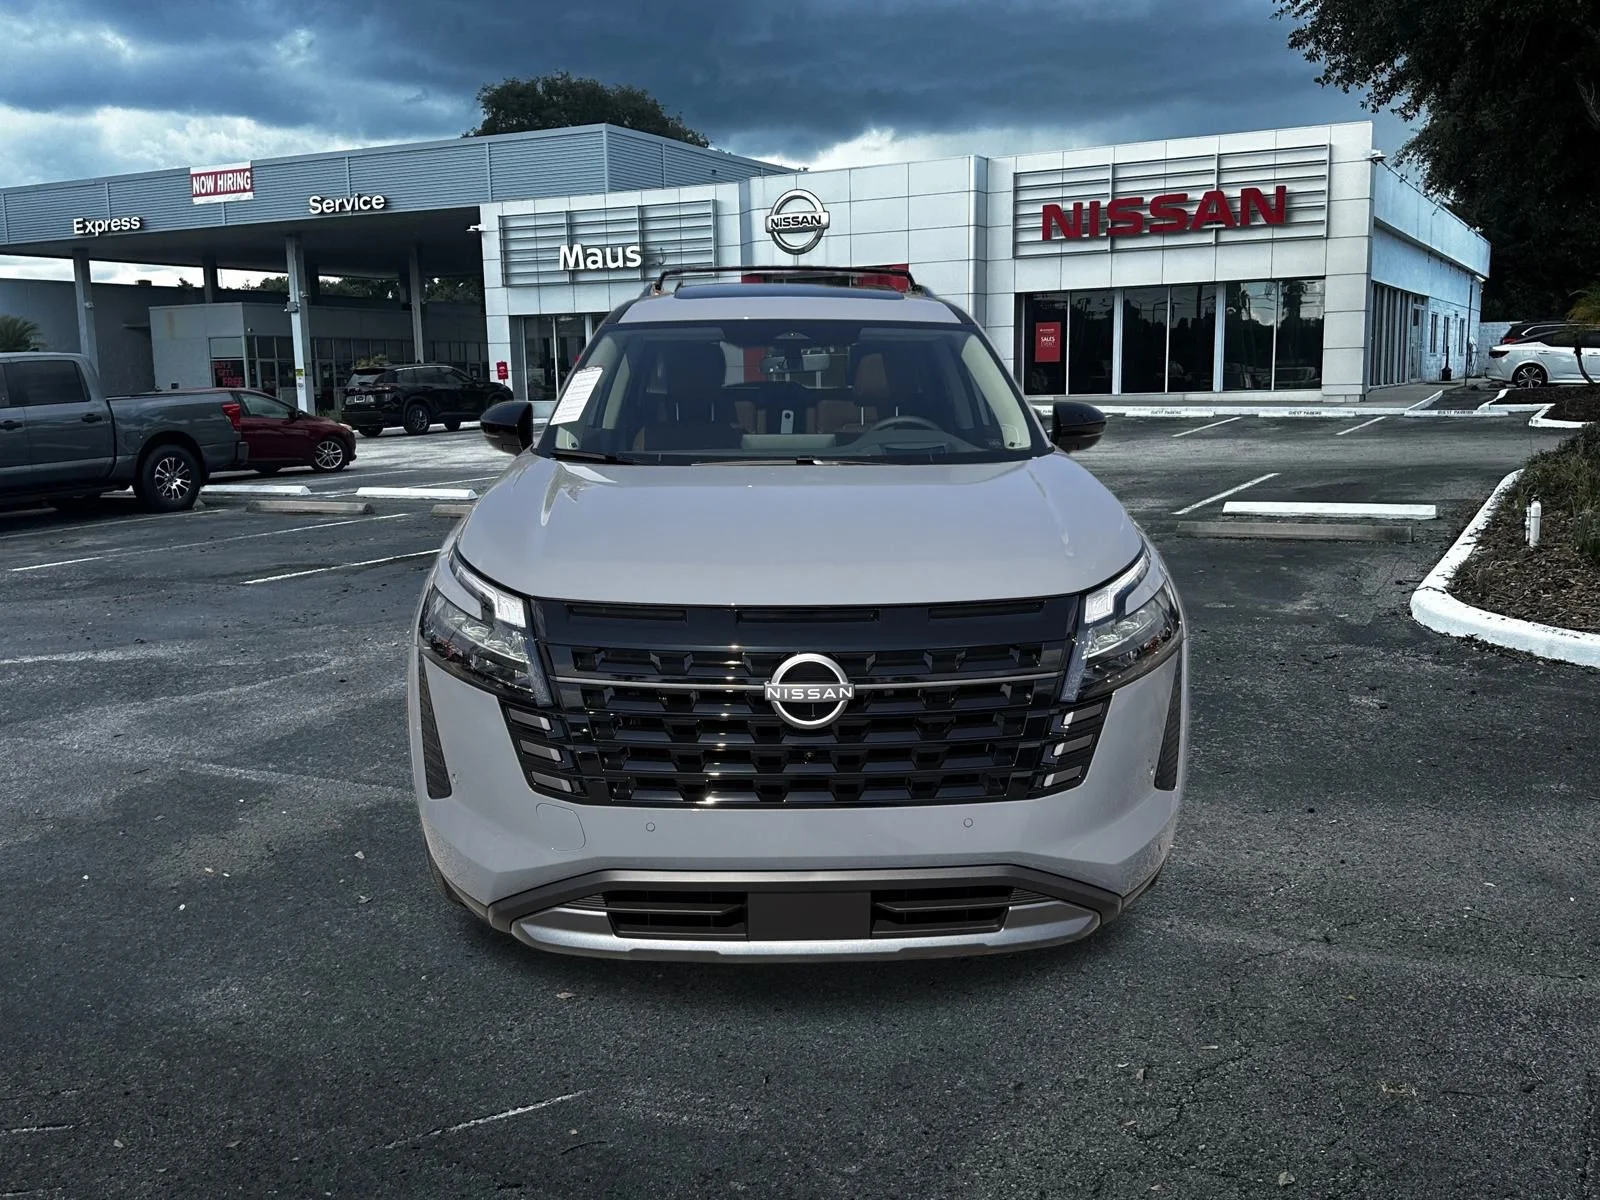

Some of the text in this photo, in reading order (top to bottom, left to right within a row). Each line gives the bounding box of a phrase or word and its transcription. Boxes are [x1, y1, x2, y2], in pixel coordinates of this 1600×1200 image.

[192, 171, 251, 195] NOW HIRING
[309, 193, 385, 214] Service
[1042, 185, 1287, 241] NISSAN
[73, 216, 141, 237] Express
[770, 215, 822, 228] NISSAN
[560, 243, 642, 271] Maus
[767, 687, 852, 700] NISSAN
